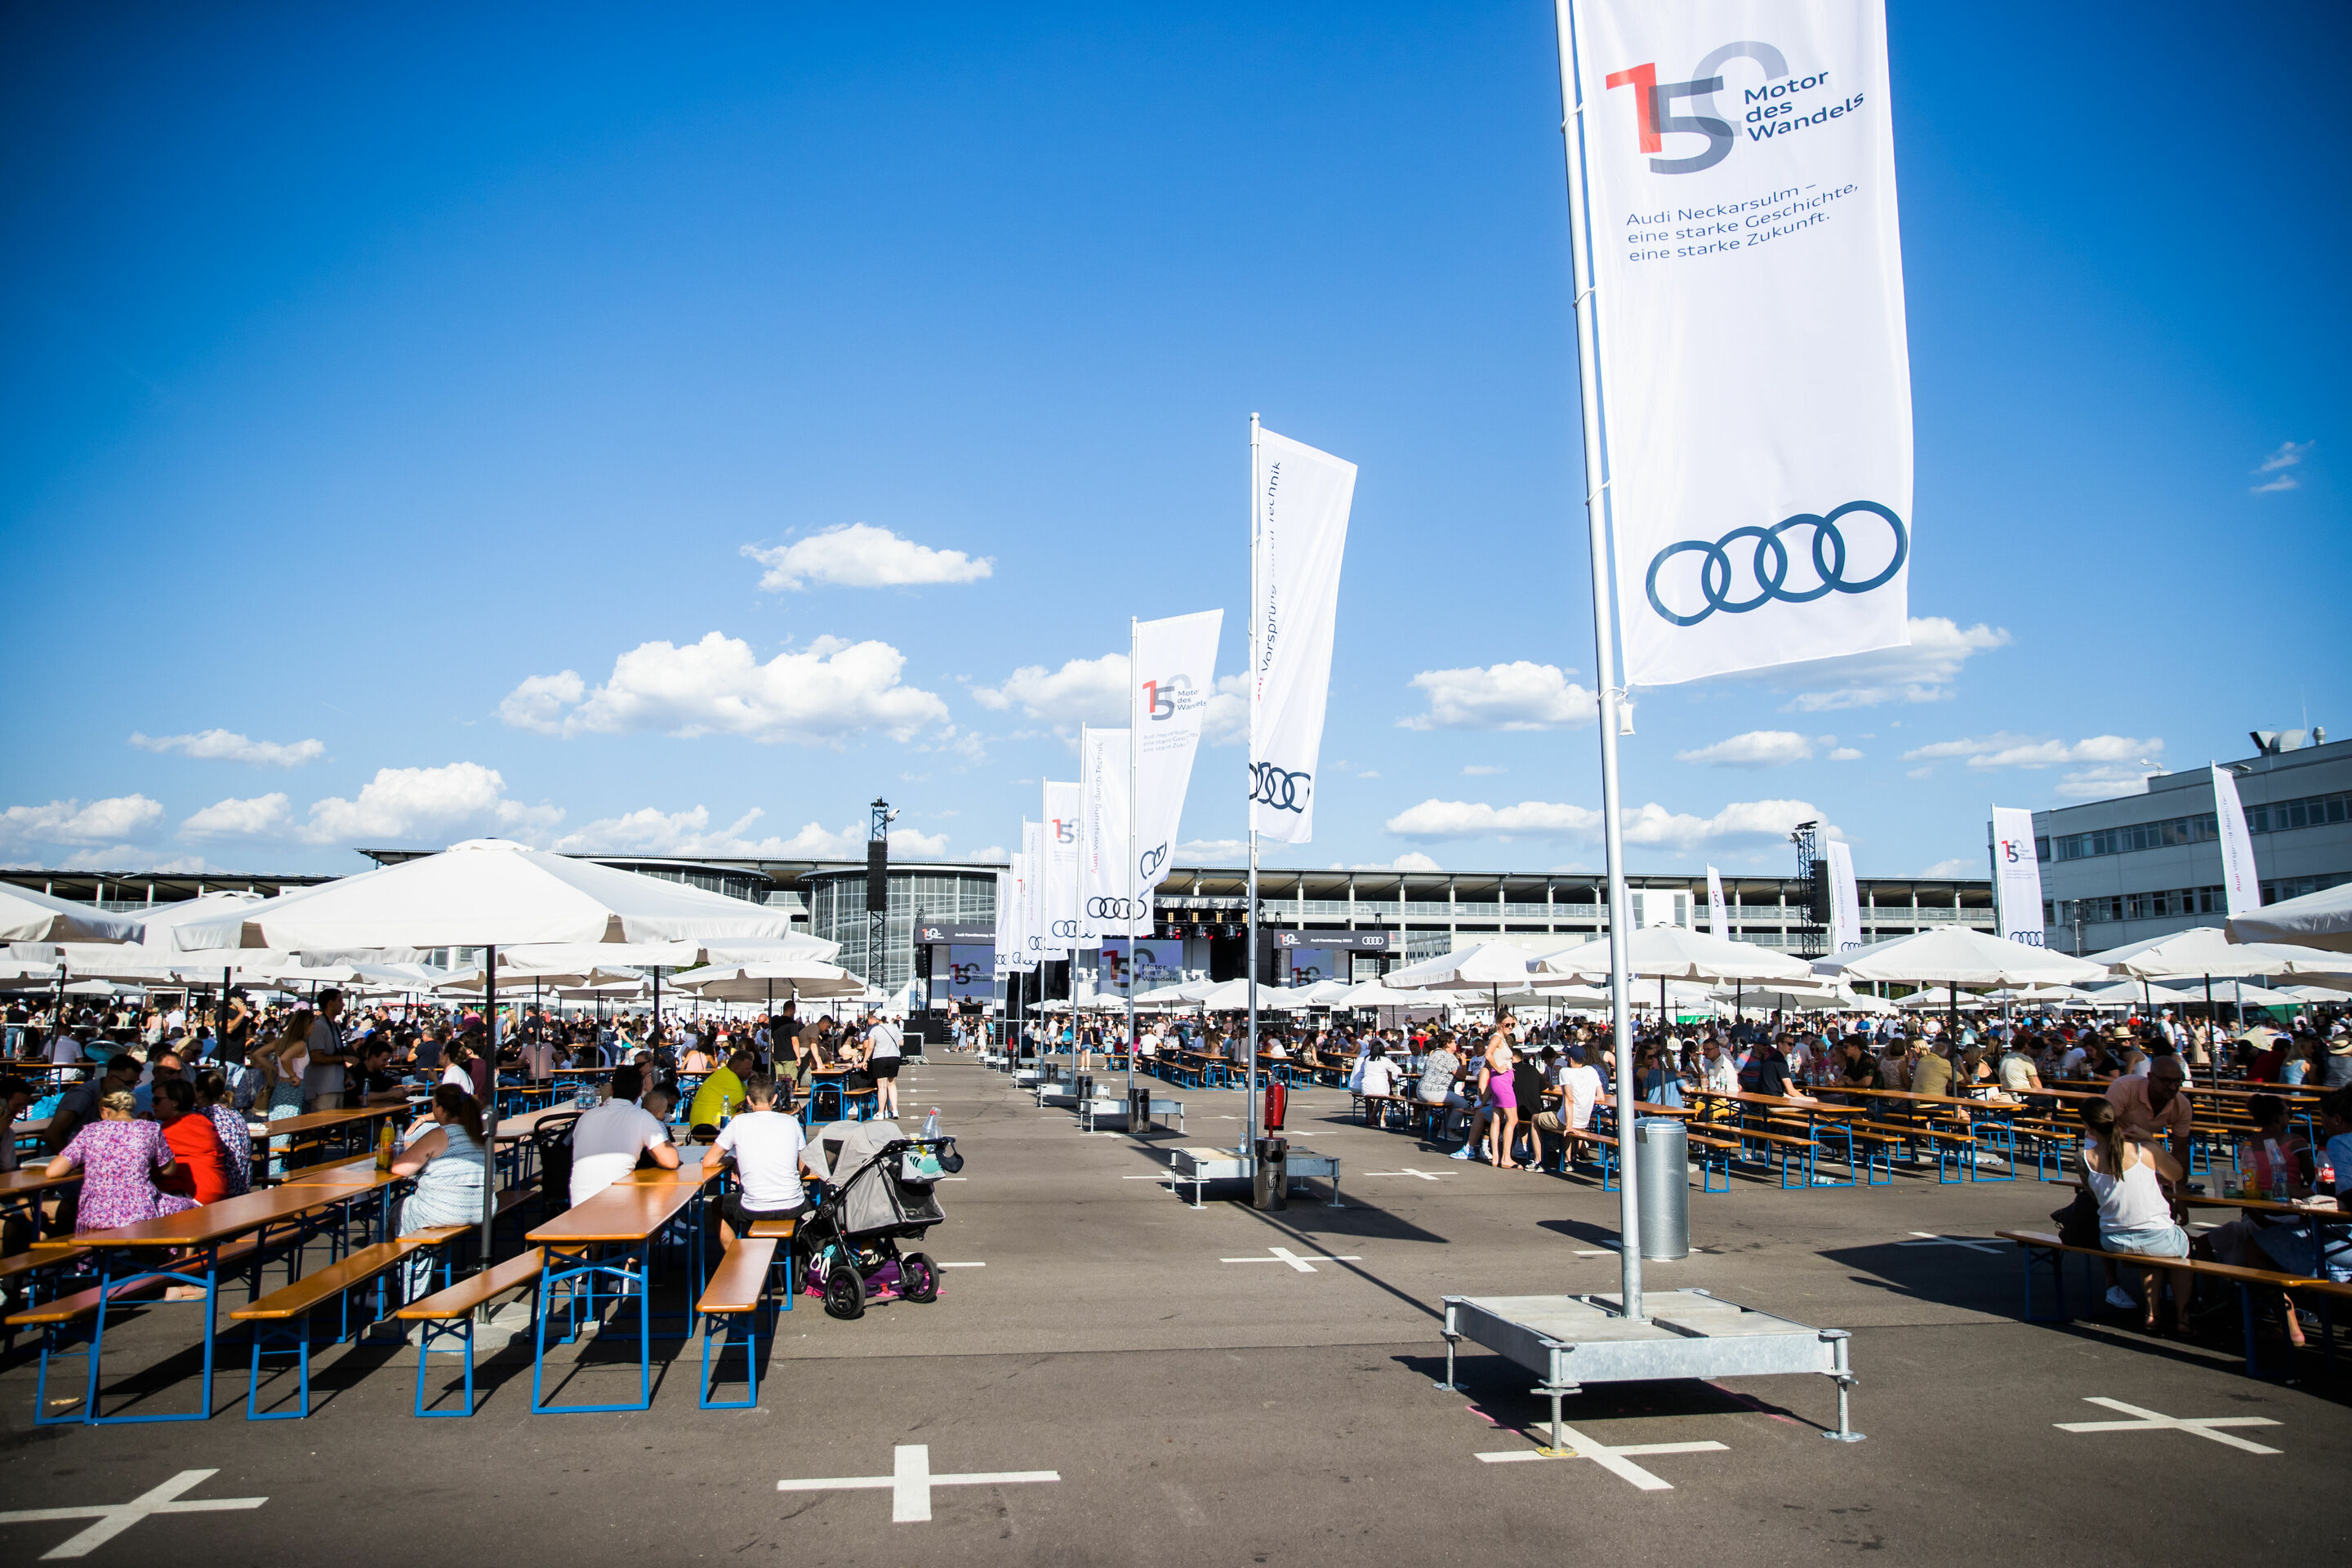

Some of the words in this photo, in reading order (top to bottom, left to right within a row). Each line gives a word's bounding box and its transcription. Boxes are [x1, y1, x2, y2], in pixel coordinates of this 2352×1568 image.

[1744, 71, 1829, 105] Motor
[1745, 100, 1793, 123] des
[1747, 92, 1864, 142] Wandels
[1626, 209, 1671, 227] Audi
[1678, 185, 1800, 221] Neckarsulm
[1628, 229, 1669, 244] eine
[1675, 220, 1739, 240] starke
[1745, 182, 1859, 229] Geschichte,
[1629, 247, 1671, 262] eine
[1677, 238, 1740, 258] starke
[1747, 213, 1831, 247] Zukunft.
[1177, 697, 1192, 705] des
[1096, 741, 1104, 774] Technik
[1094, 804, 1102, 851] Vorsprung
